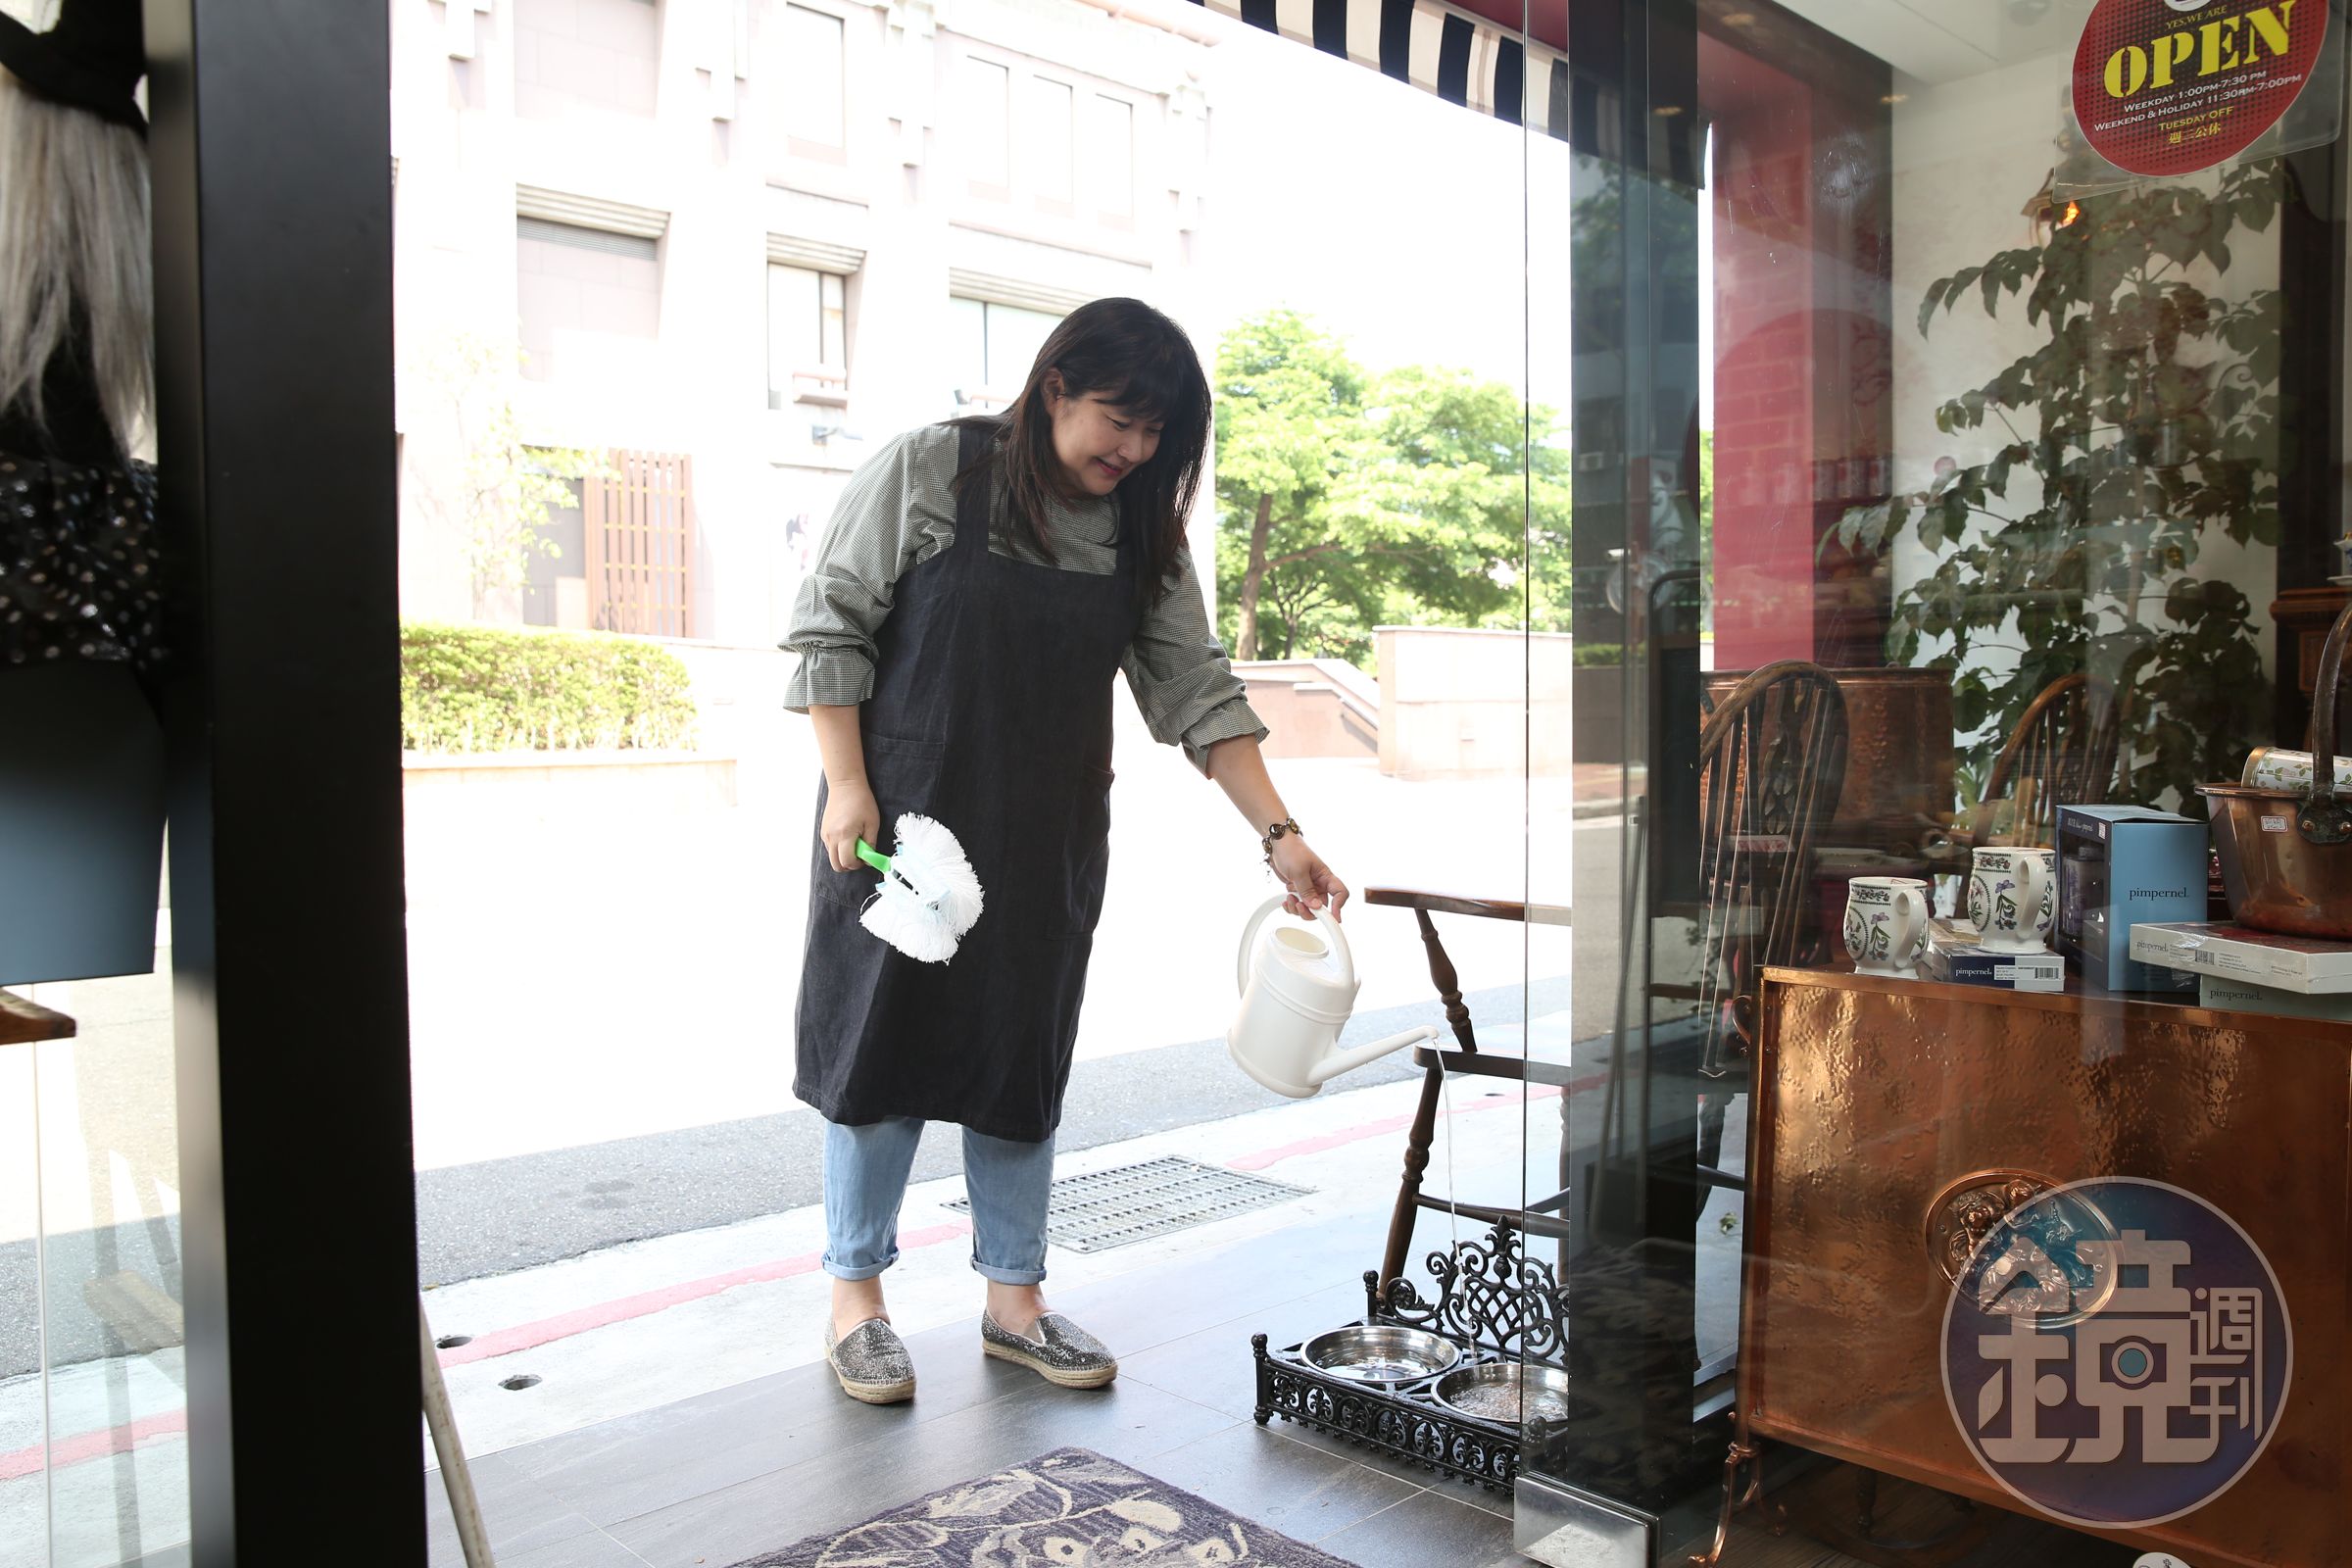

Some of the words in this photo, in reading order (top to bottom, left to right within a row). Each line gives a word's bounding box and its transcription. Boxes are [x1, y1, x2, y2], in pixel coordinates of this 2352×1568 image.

[2205, 5, 2228, 19] ARE
[2103, 0, 2297, 98] OPEN
[2124, 94, 2175, 113] WEEKDAY
[2249, 70, 2267, 81] PM
[2093, 114, 2146, 131] WEEKEND
[2158, 99, 2204, 117] HOLIDAY
[2158, 113, 2208, 130] TUESDAY
[2208, 106, 2234, 119] OFF
